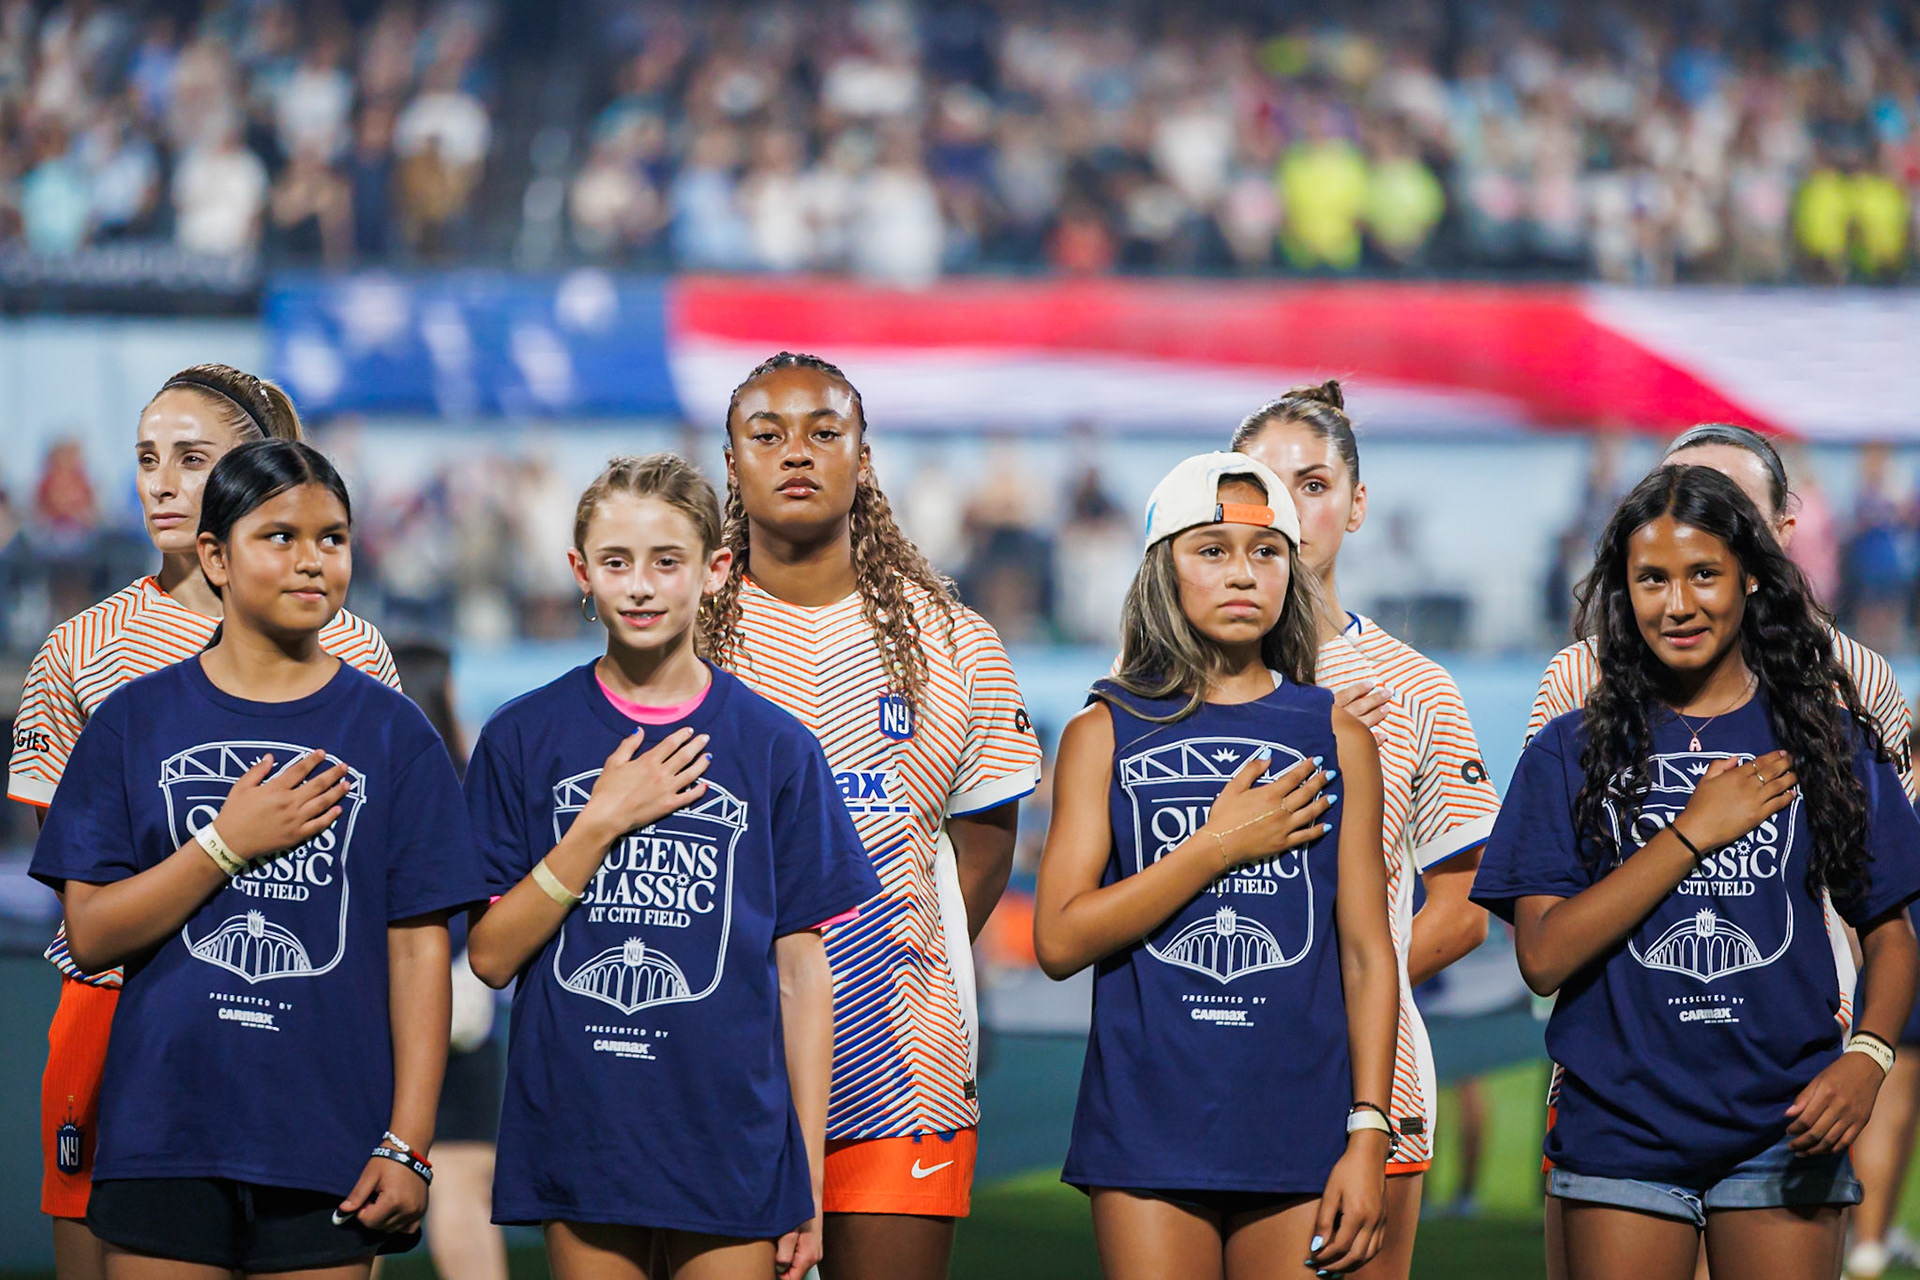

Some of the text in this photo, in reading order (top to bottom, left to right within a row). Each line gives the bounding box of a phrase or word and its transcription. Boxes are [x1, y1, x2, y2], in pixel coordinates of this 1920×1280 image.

[884, 702, 910, 735] NY
[595, 836, 718, 880] UEENS
[263, 882, 309, 902] FIELD
[1233, 878, 1279, 895] FIELD
[1710, 880, 1755, 896] FIELD
[588, 907, 691, 928] AT CITI FIELD
[209, 992, 270, 1007] PRESENTED
[1182, 994, 1243, 1004] PRESENTED
[1668, 994, 1726, 1005] PRESENTED
[585, 1025, 646, 1036] PRESENTED
[60, 1136, 79, 1166] NY
